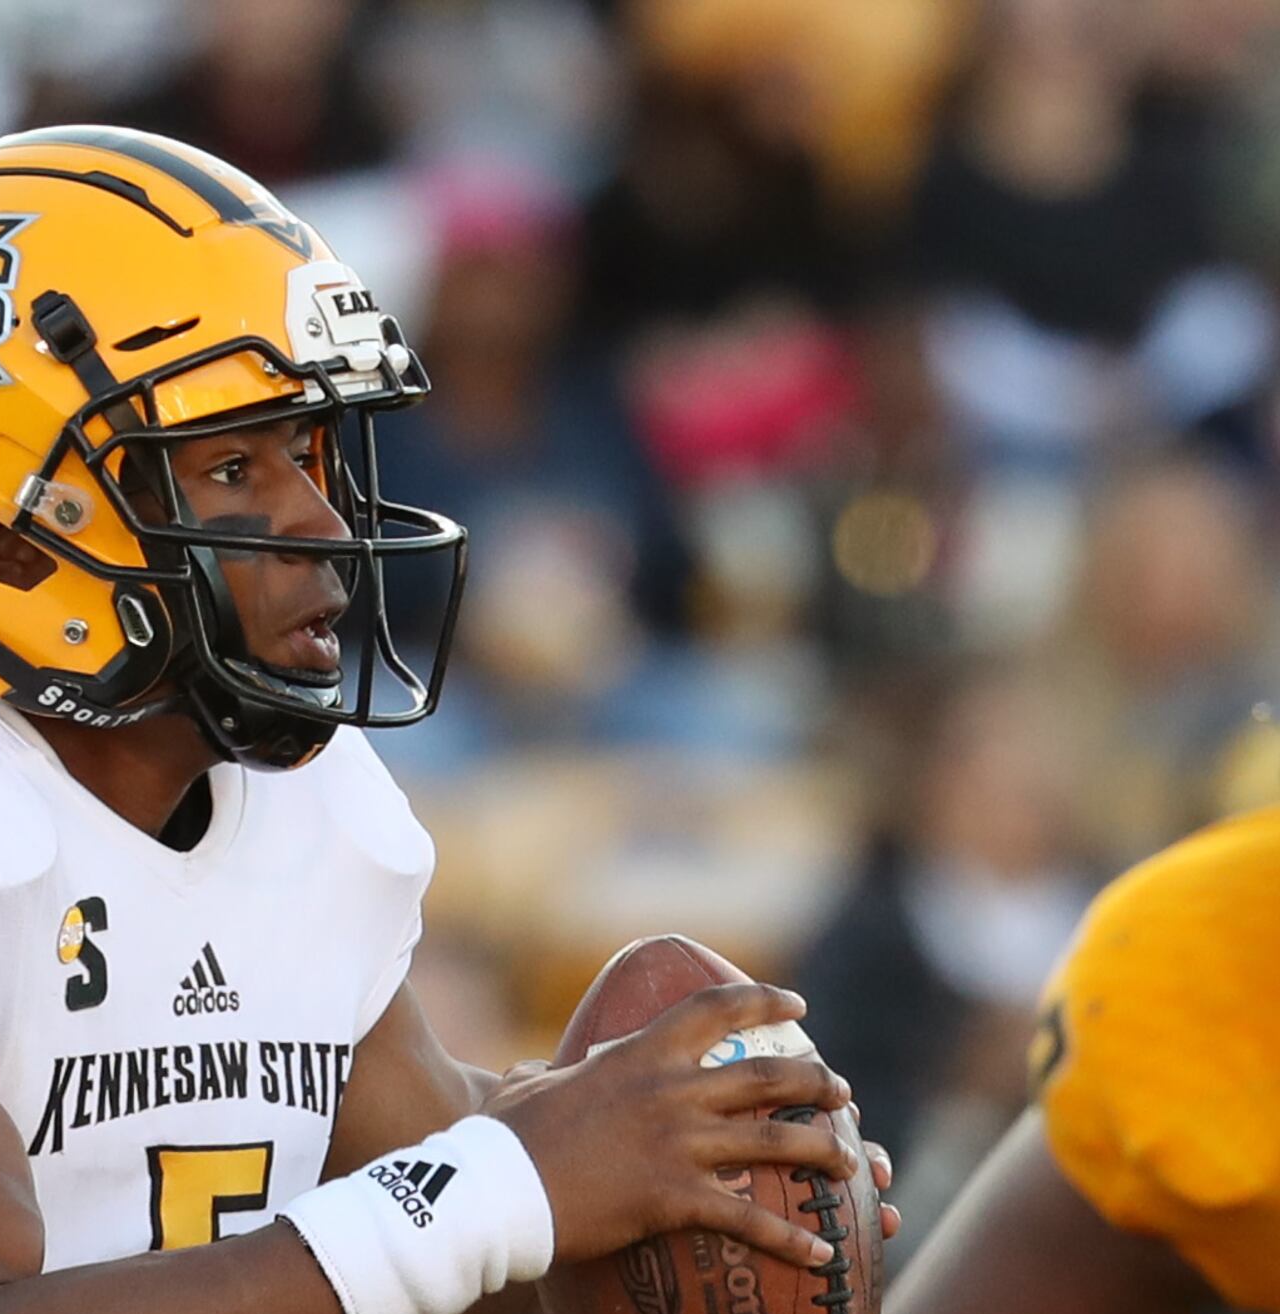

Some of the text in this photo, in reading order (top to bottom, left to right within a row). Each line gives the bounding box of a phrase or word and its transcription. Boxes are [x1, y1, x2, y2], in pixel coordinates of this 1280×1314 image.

[172, 987, 241, 1017] adidas
[27, 1039, 249, 1157] KENNESAW
[367, 1164, 434, 1229] adidas
